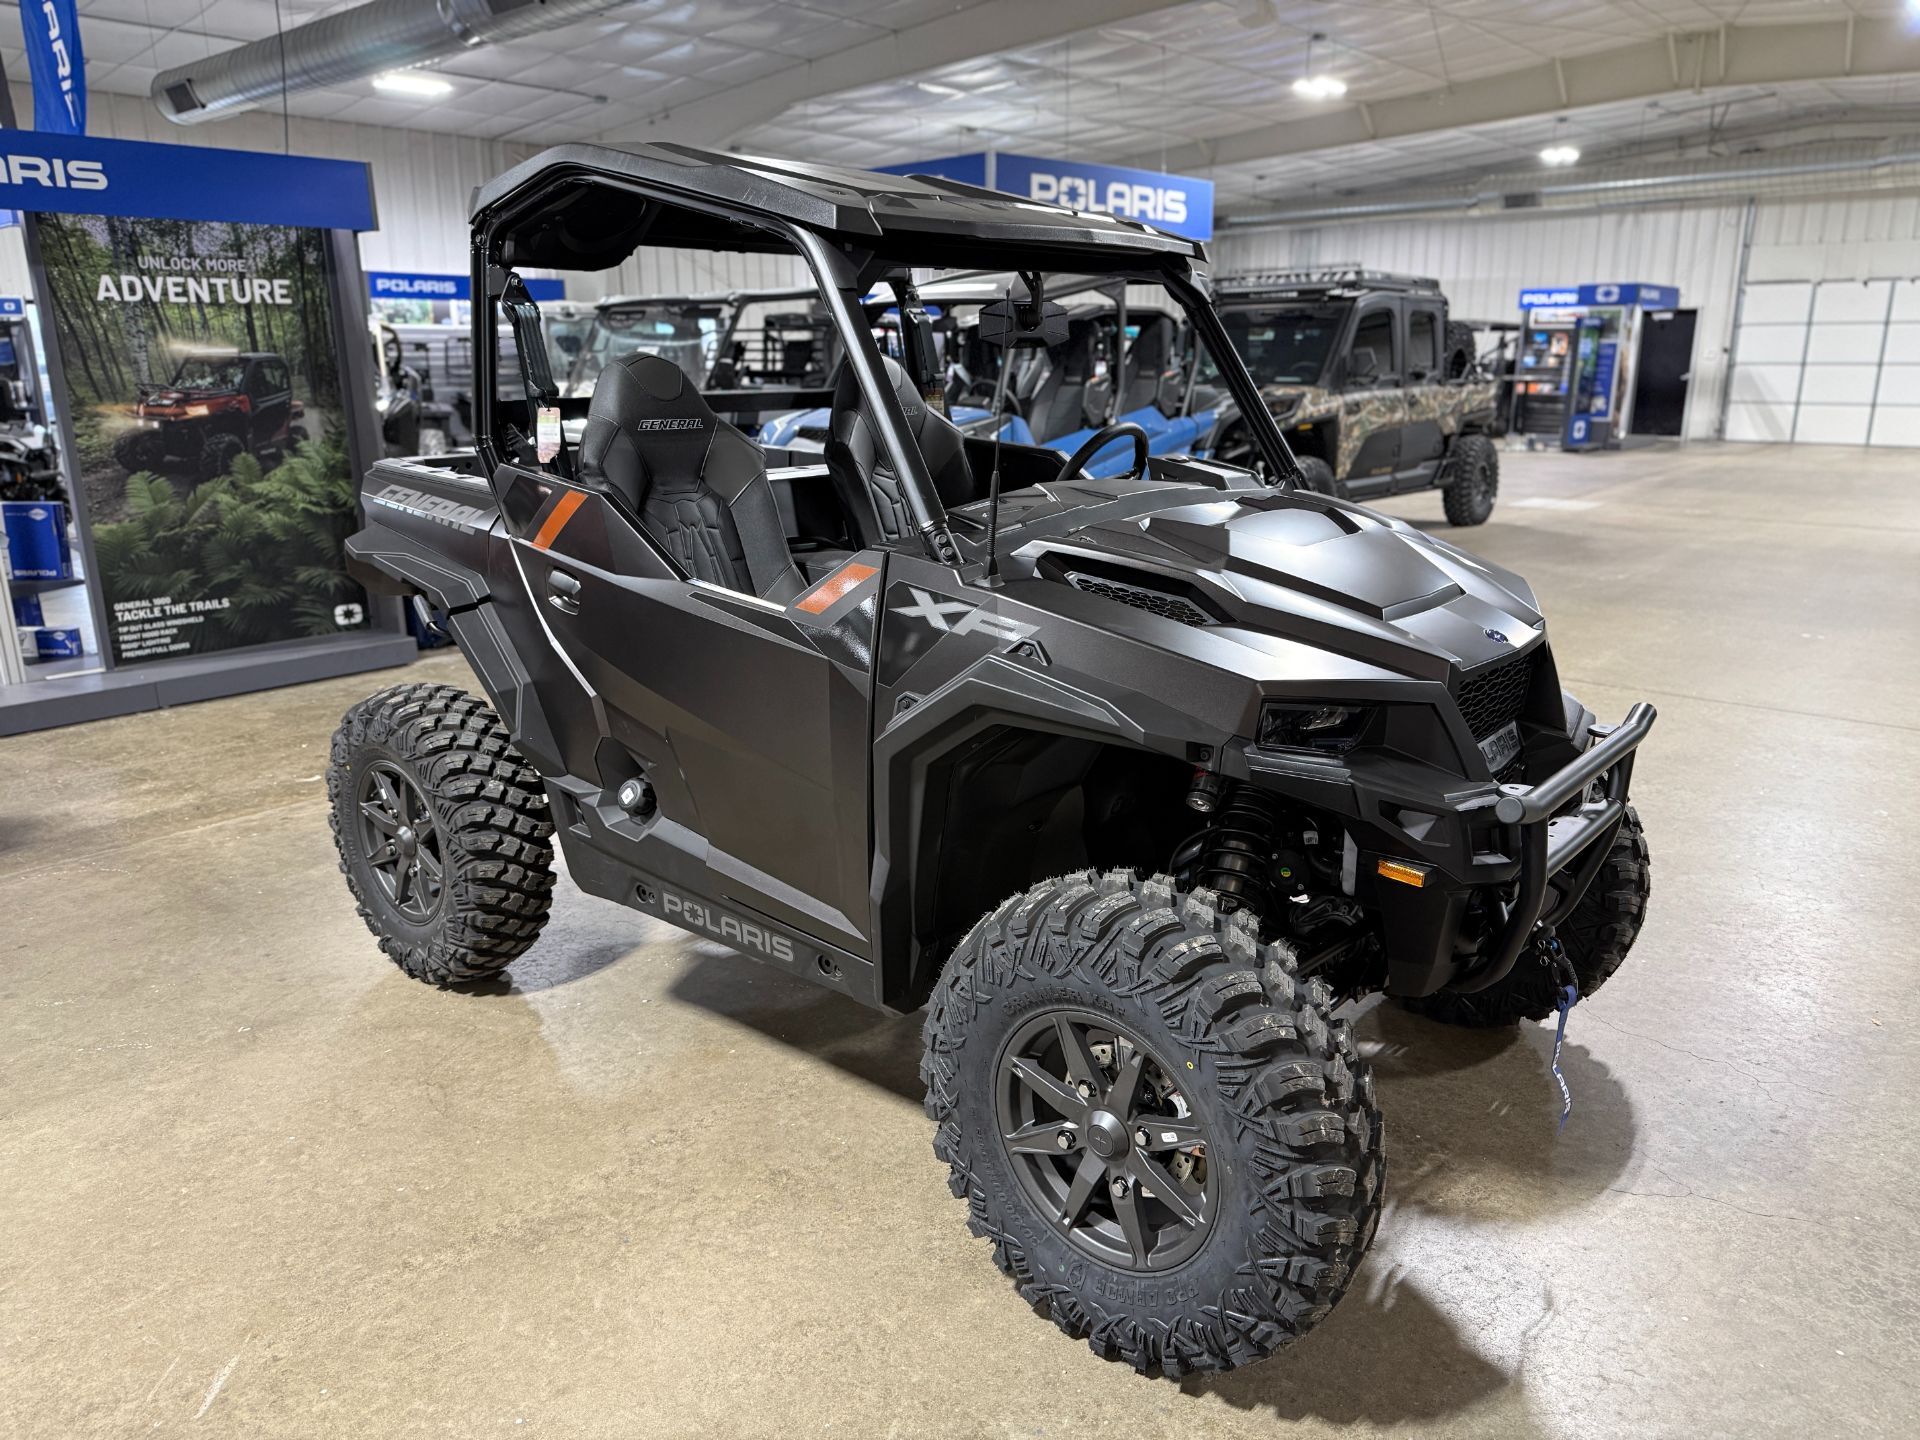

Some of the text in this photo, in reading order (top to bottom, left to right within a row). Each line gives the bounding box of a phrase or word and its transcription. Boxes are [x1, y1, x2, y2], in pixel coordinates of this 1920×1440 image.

[0, 154, 108, 191] RIS
[1030, 172, 1188, 224] POLARIS
[138, 255, 248, 272] UNLOCK MORE
[97, 274, 293, 304] ADVENTURE
[376, 278, 457, 294] POLARIS
[638, 418, 704, 431] GENERAL
[373, 484, 486, 536] GENERAL
[114, 599, 152, 611] GENERAL
[115, 597, 230, 623] TACKLE THE TRAILS
[662, 892, 794, 962] POLARIS
[1552, 1041, 1572, 1114] POLARIS
